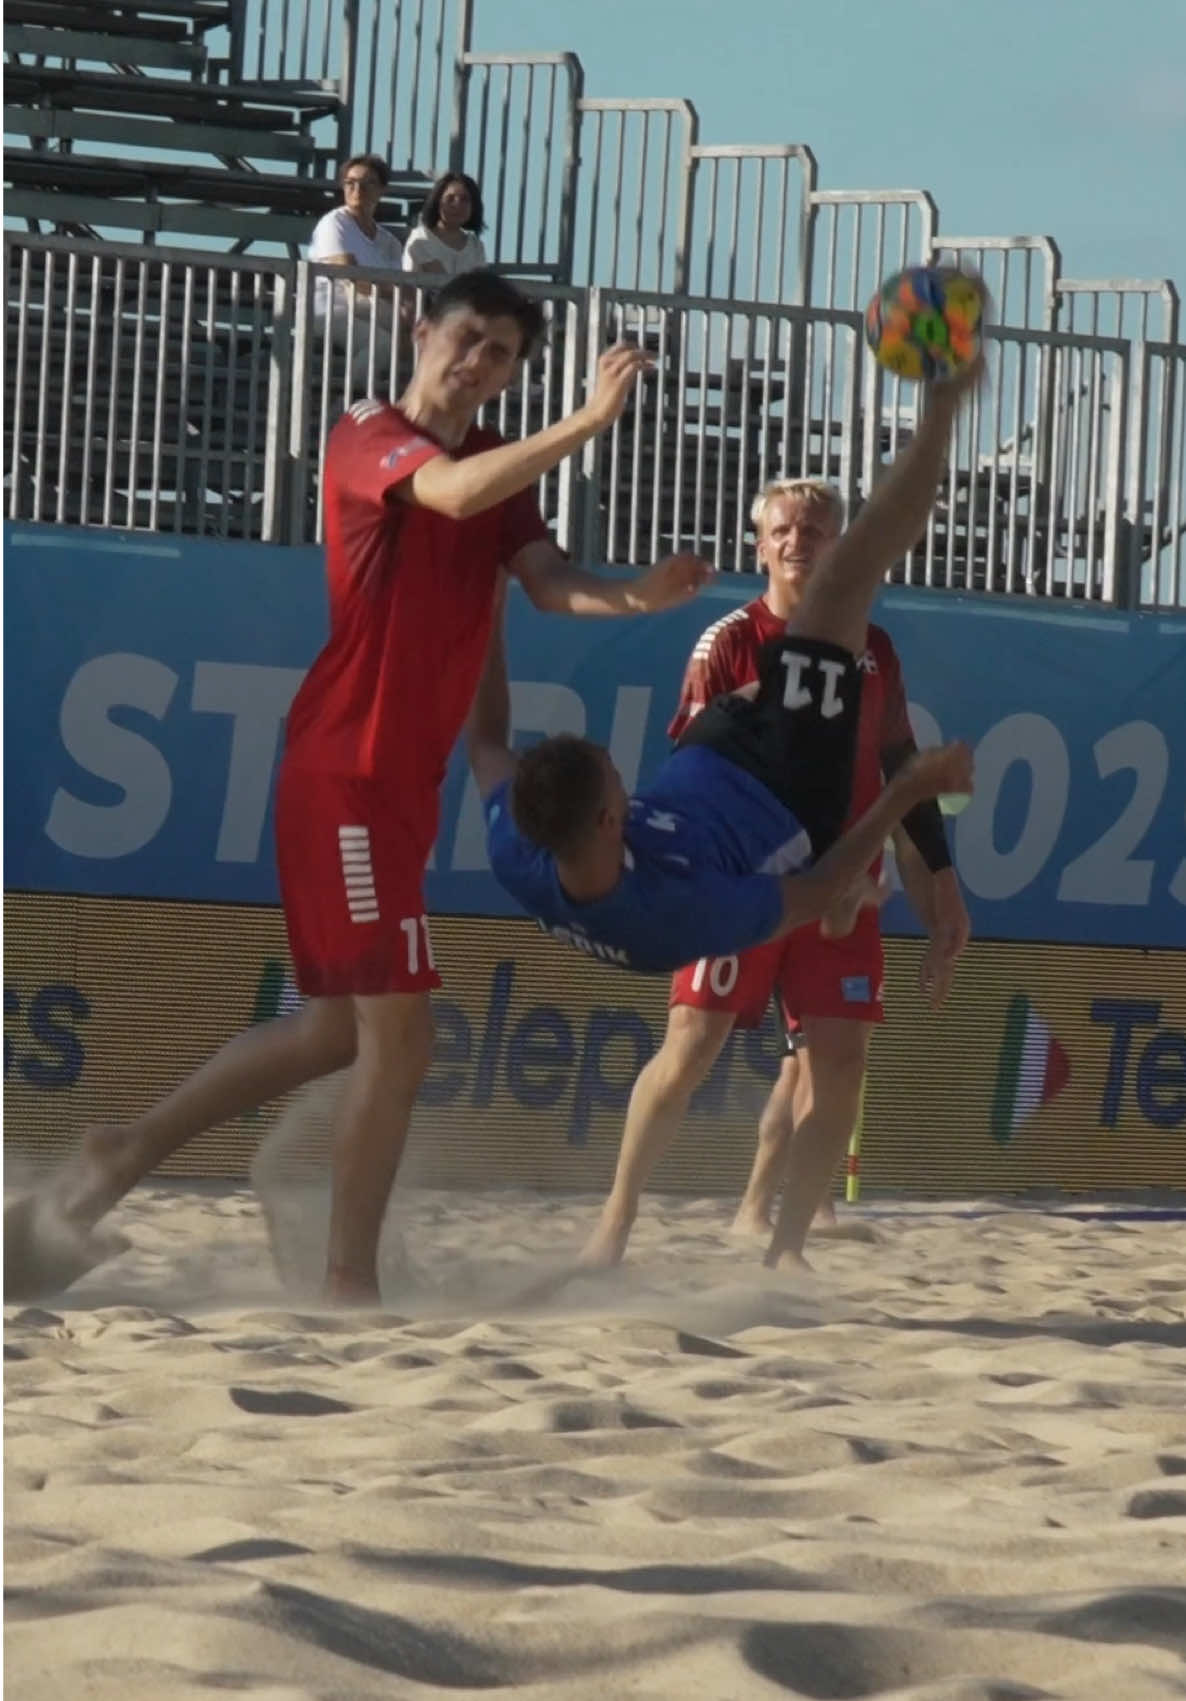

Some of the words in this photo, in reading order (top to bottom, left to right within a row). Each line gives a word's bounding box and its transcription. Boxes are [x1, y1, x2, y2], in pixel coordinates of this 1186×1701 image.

[780, 650, 846, 719] 11
[885, 700, 1186, 907] 02
[690, 955, 739, 998] 10
[4, 983, 93, 1090] s
